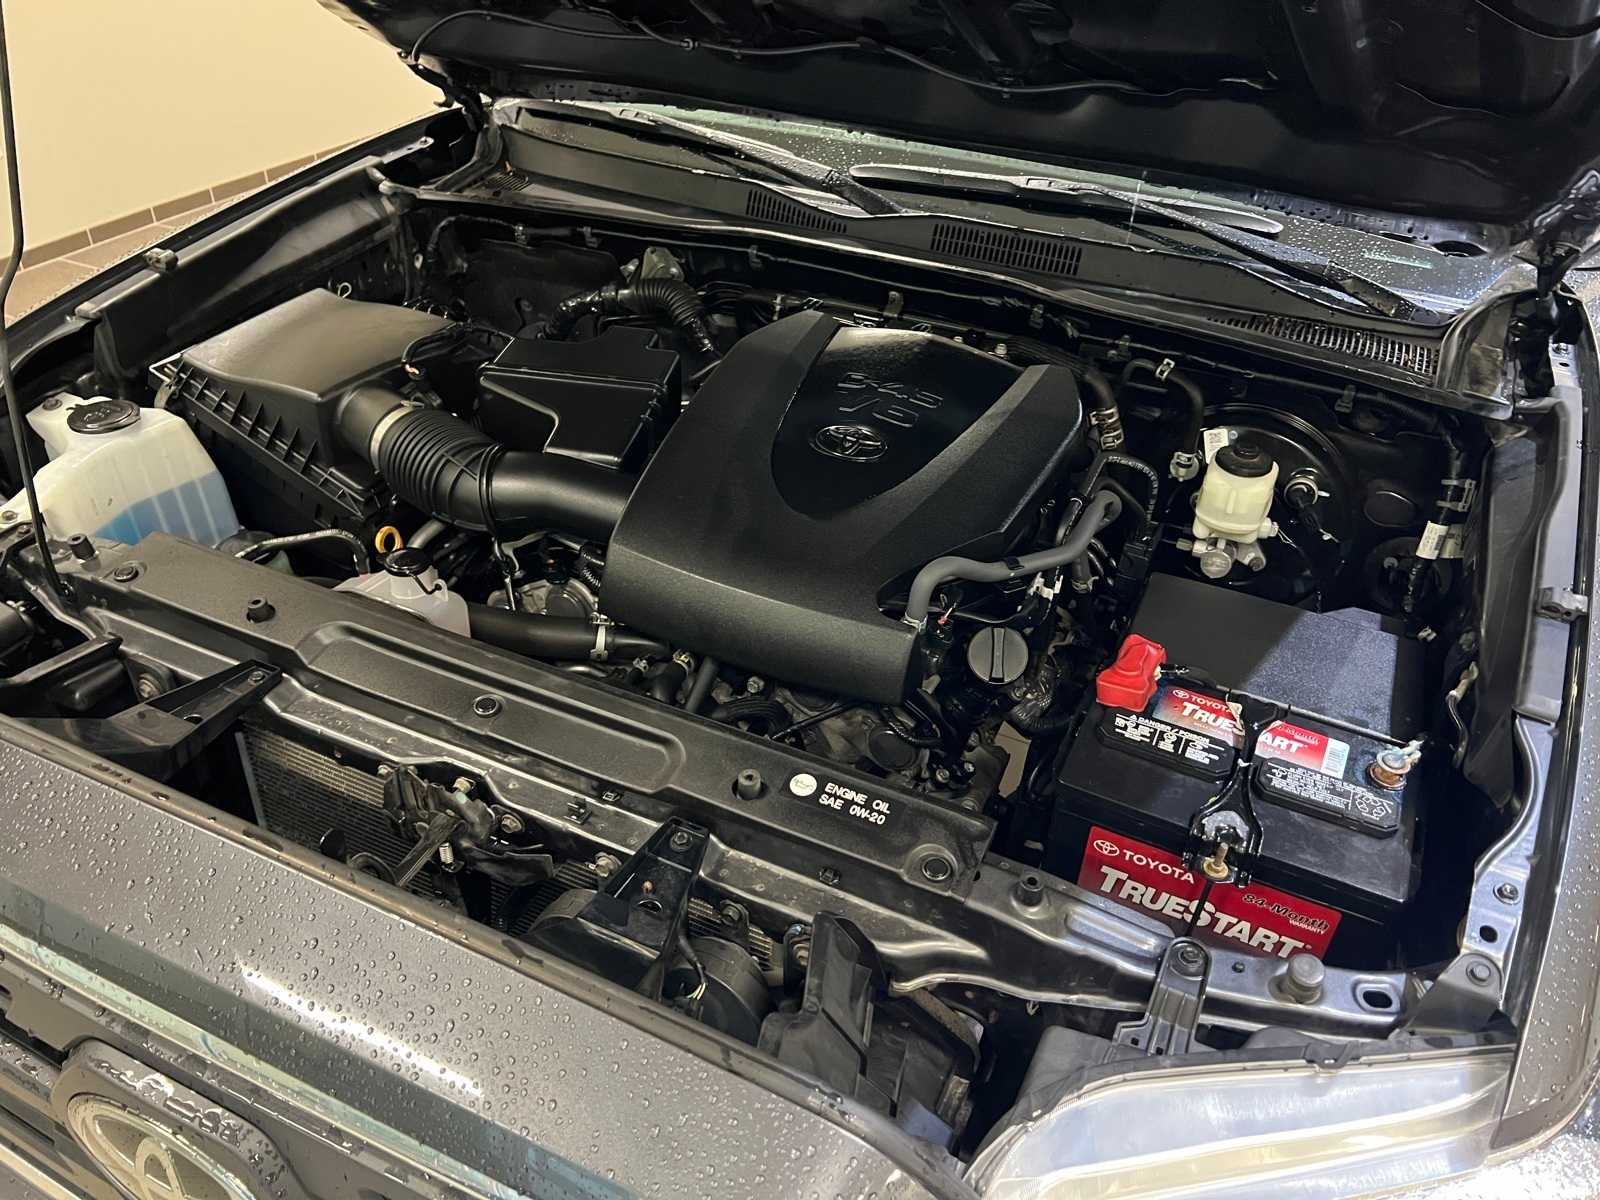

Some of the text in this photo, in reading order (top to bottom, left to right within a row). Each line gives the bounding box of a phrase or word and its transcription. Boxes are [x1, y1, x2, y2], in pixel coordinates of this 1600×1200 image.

[818, 793, 886, 825] SAE 0W-20
[824, 782, 891, 814] ENGINE OIL
[1123, 849, 1195, 884] TOYOTA
[1289, 920, 1325, 935] WARRANTY
